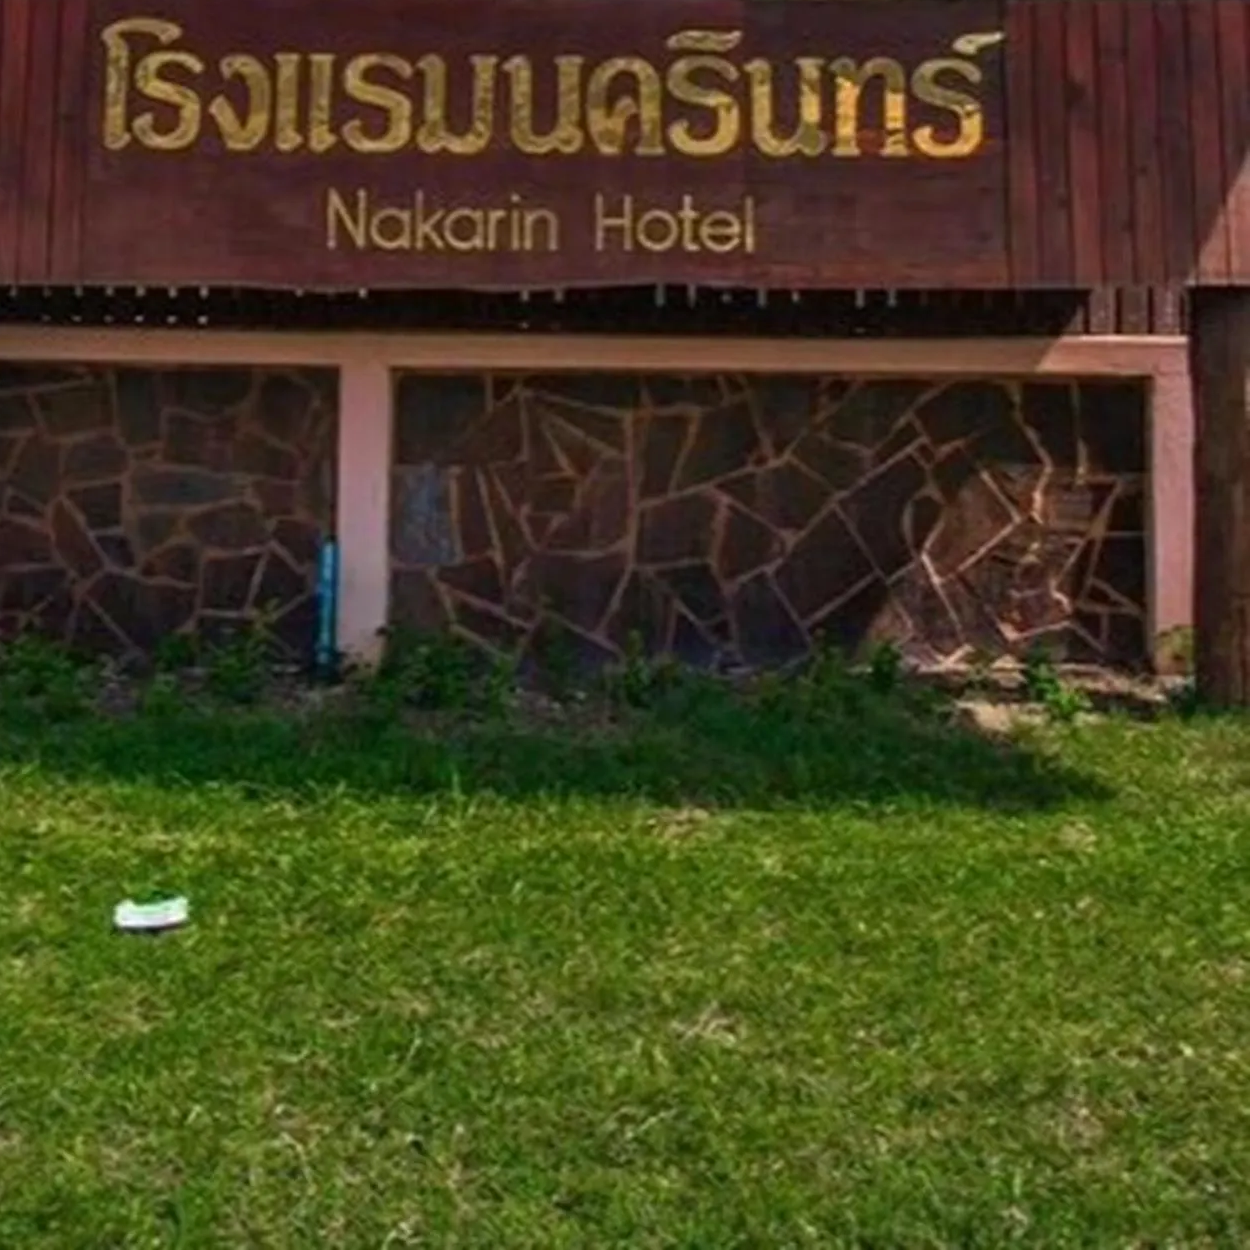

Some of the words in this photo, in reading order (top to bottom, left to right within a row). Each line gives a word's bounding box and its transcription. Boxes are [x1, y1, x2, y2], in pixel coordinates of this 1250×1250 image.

[100, 17, 1005, 158] โรงแรมนครินทร์
[327, 187, 558, 254] Nakarin
[594, 194, 757, 255] Hotel
